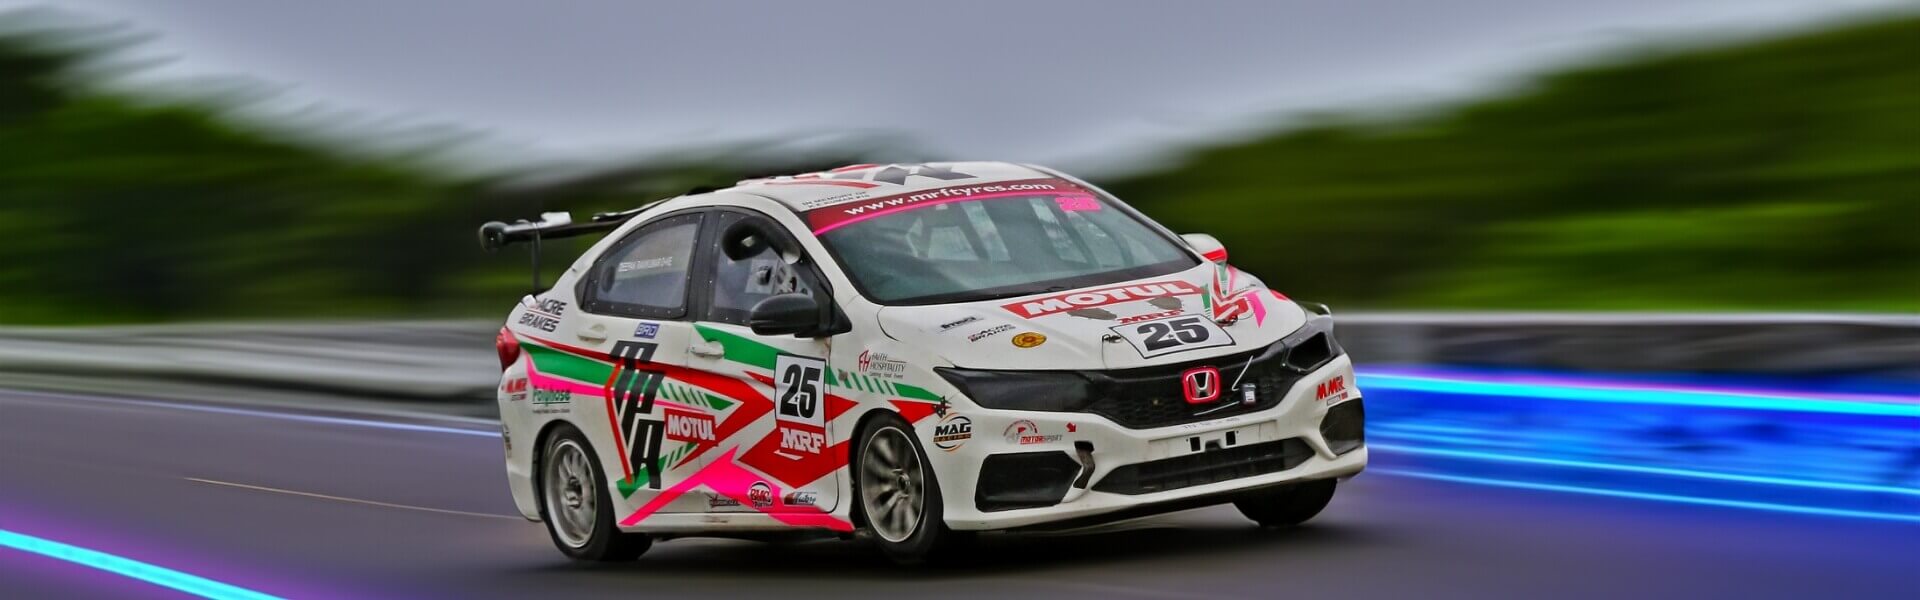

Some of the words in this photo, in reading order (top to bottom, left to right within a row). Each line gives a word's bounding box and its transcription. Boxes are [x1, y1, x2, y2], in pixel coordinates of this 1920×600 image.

[844, 182, 1056, 216] www.mrftyres.com
[539, 298, 567, 316] ACRE
[1021, 281, 1194, 316] MOTUL
[518, 313, 560, 333] BRAKES
[1117, 310, 1184, 324] MRF
[1137, 317, 1210, 352] 25
[869, 361, 906, 374] HOSPITALITY
[871, 352, 888, 362] FAITH
[780, 364, 822, 419] 25
[667, 414, 716, 441] MOTUL
[934, 423, 972, 436] MAG
[779, 426, 826, 455] MRF
